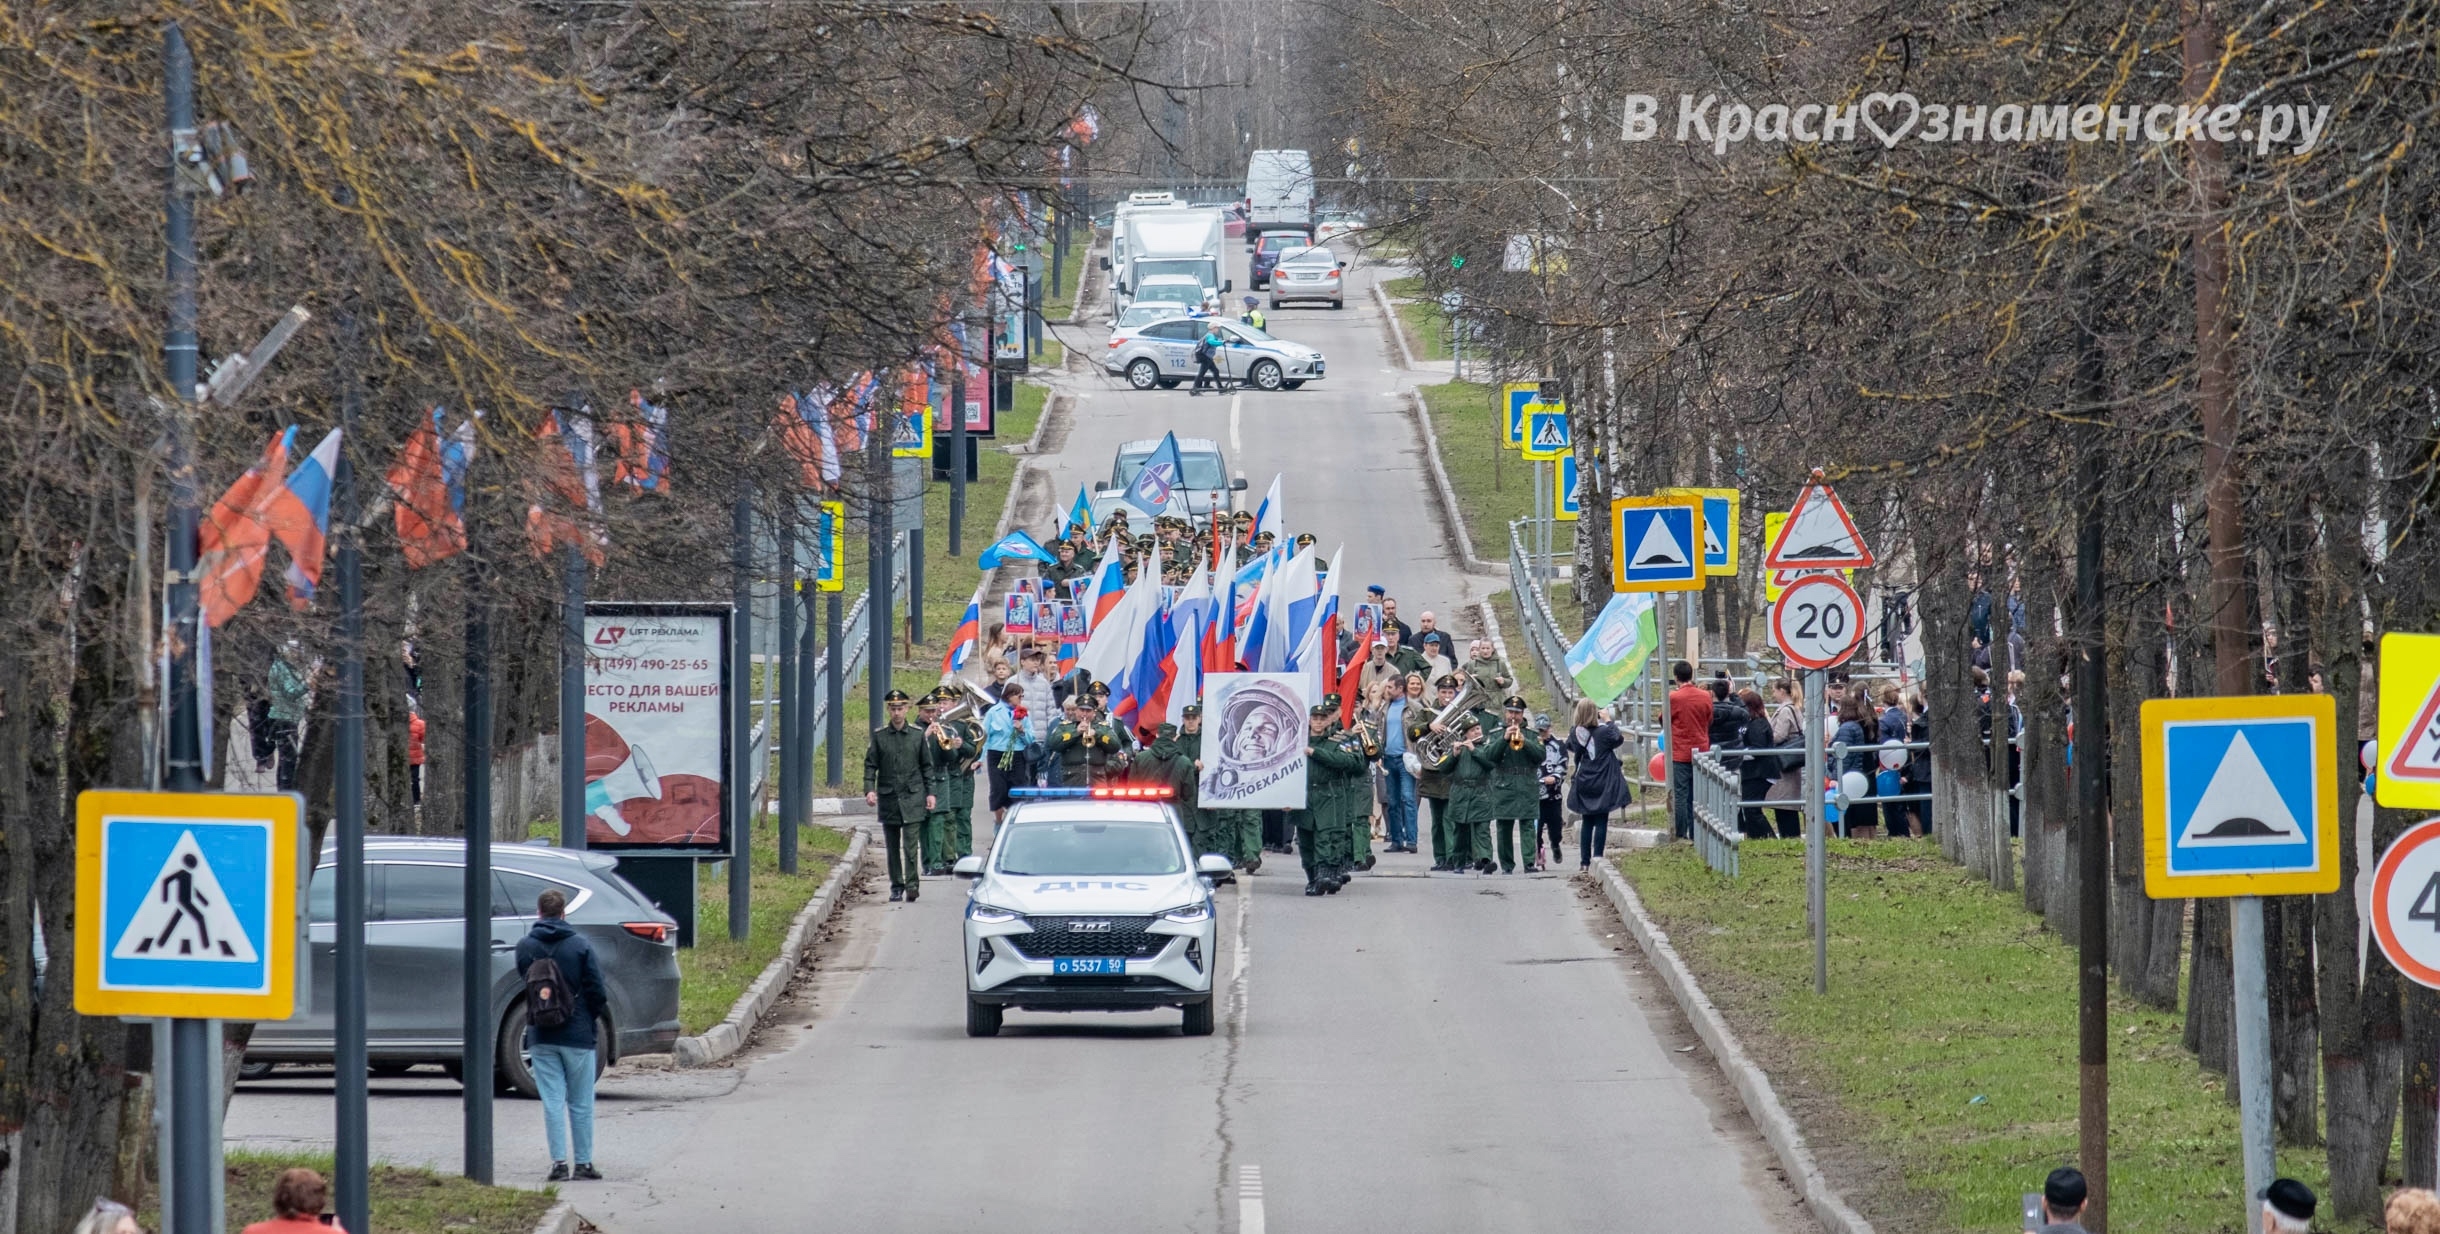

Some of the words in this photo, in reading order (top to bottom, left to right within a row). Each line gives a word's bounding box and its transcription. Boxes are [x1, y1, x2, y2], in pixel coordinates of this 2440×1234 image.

[1171, 359, 1186, 368] 112
[1796, 603, 1845, 639] 20
[640, 659, 708, 670] 490-25-65
[584, 685, 625, 696] ЕСТО
[629, 685, 660, 698] ДЛЯ
[665, 682, 719, 696] ВАШЕЙ
[609, 702, 684, 712] РЕКЛАМЫ
[1237, 757, 1304, 800] ПОЕХАЛИ!
[1033, 881, 1149, 894] ДПС
[2408, 871, 2440, 933] 4
[1072, 959, 1102, 972] 5537
[1109, 959, 1121, 969] 50
